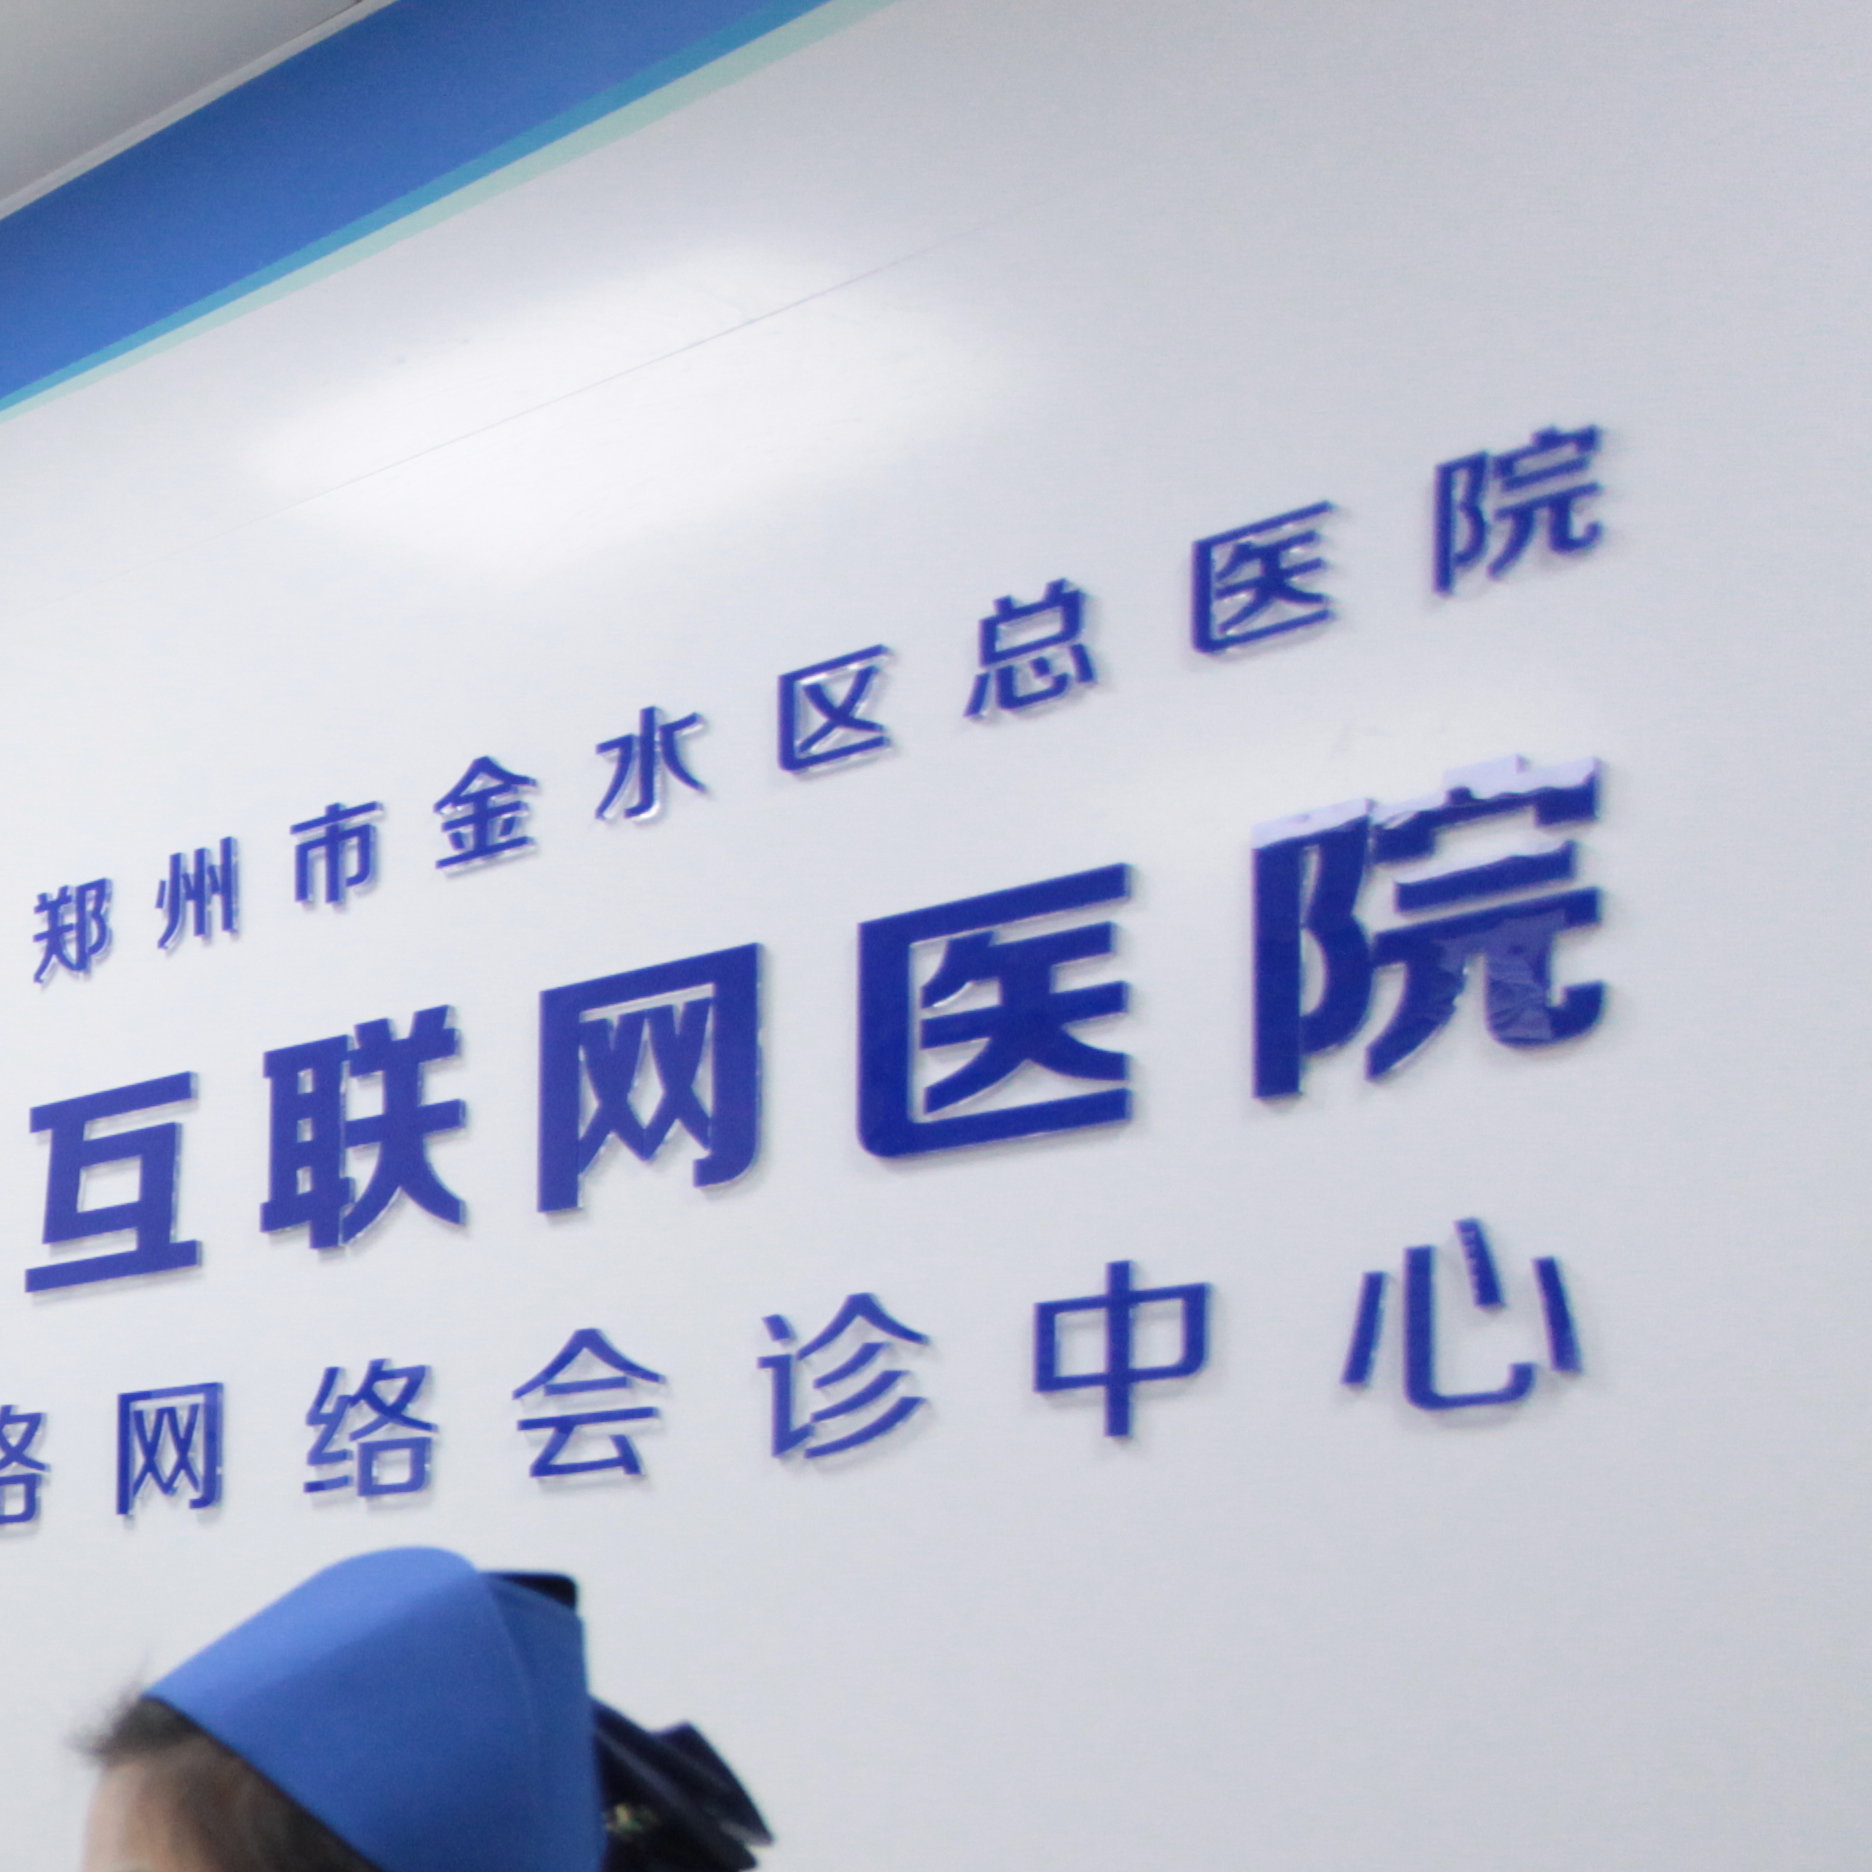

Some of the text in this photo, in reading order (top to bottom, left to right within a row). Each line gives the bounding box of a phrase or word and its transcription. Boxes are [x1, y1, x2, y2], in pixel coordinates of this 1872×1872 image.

[32, 422, 1606, 985] 郑州市金水区总医院
[25, 752, 1608, 1296] 互联网医院
